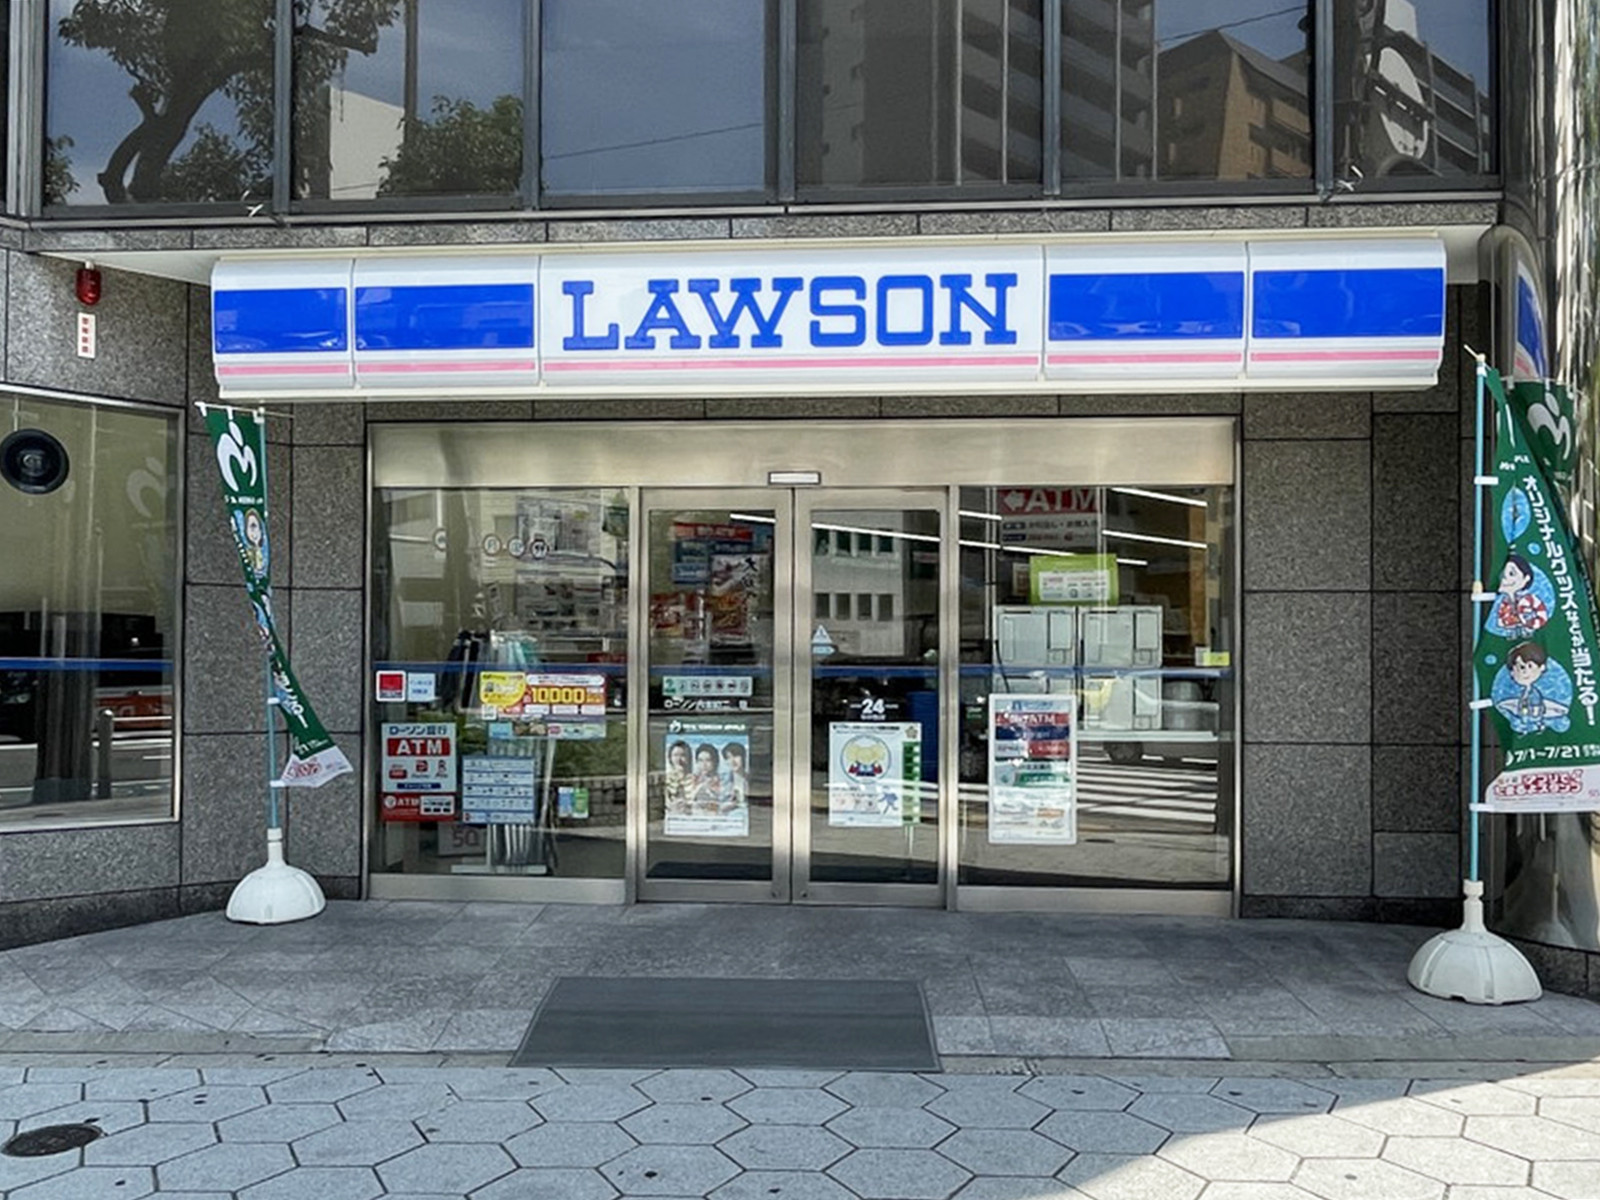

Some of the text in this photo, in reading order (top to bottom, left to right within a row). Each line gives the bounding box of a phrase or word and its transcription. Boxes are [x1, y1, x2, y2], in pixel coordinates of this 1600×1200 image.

[562, 273, 1017, 351] LAWSON
[1025, 488, 1098, 512] ATM
[861, 697, 885, 715] 24
[389, 725, 447, 736] ローソン銀行
[396, 739, 443, 756] ATM
